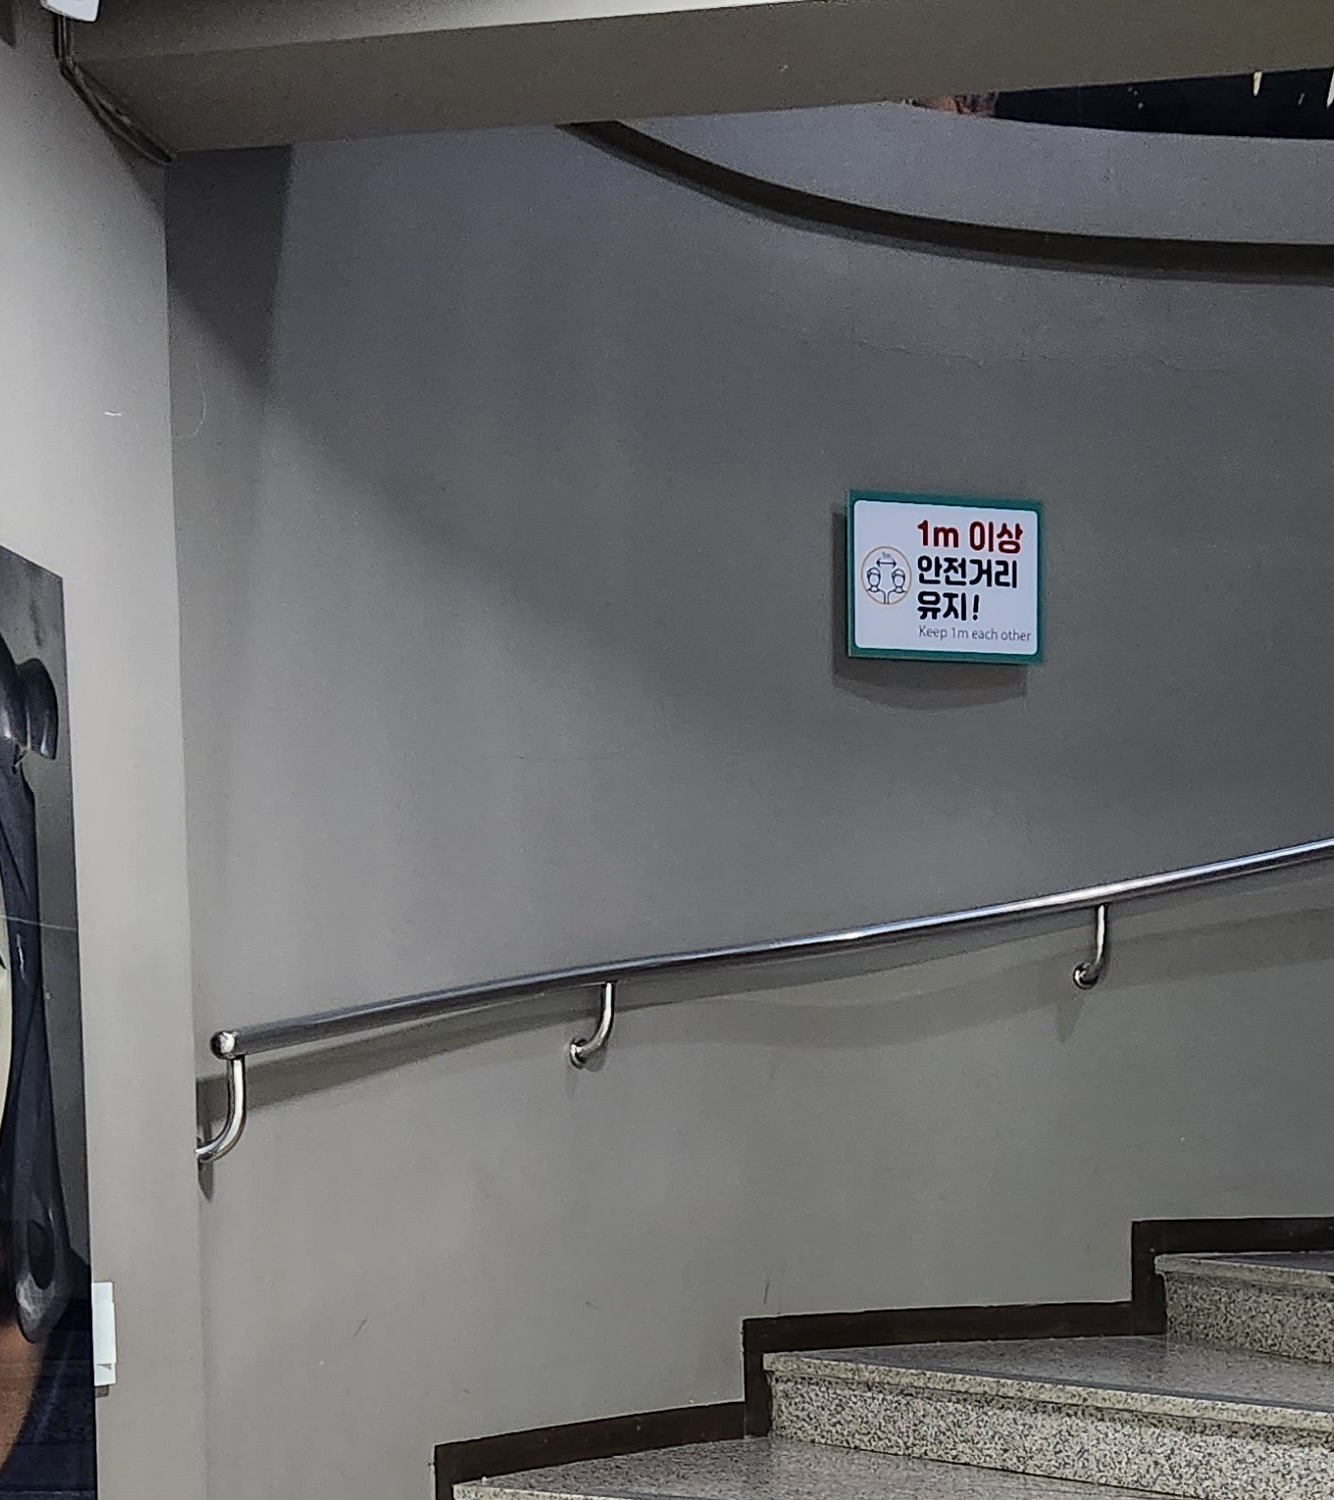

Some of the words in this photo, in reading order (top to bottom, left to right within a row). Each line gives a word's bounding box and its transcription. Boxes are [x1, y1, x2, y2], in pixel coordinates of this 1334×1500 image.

[917, 519, 959, 548] 1m
[968, 520, 1023, 554] 이상
[917, 555, 1018, 588] 안전거리
[917, 591, 980, 621] 유지!
[919, 625, 948, 640] Keep
[952, 627, 969, 639] 1m
[971, 628, 998, 640] each
[1000, 629, 1032, 641] other
